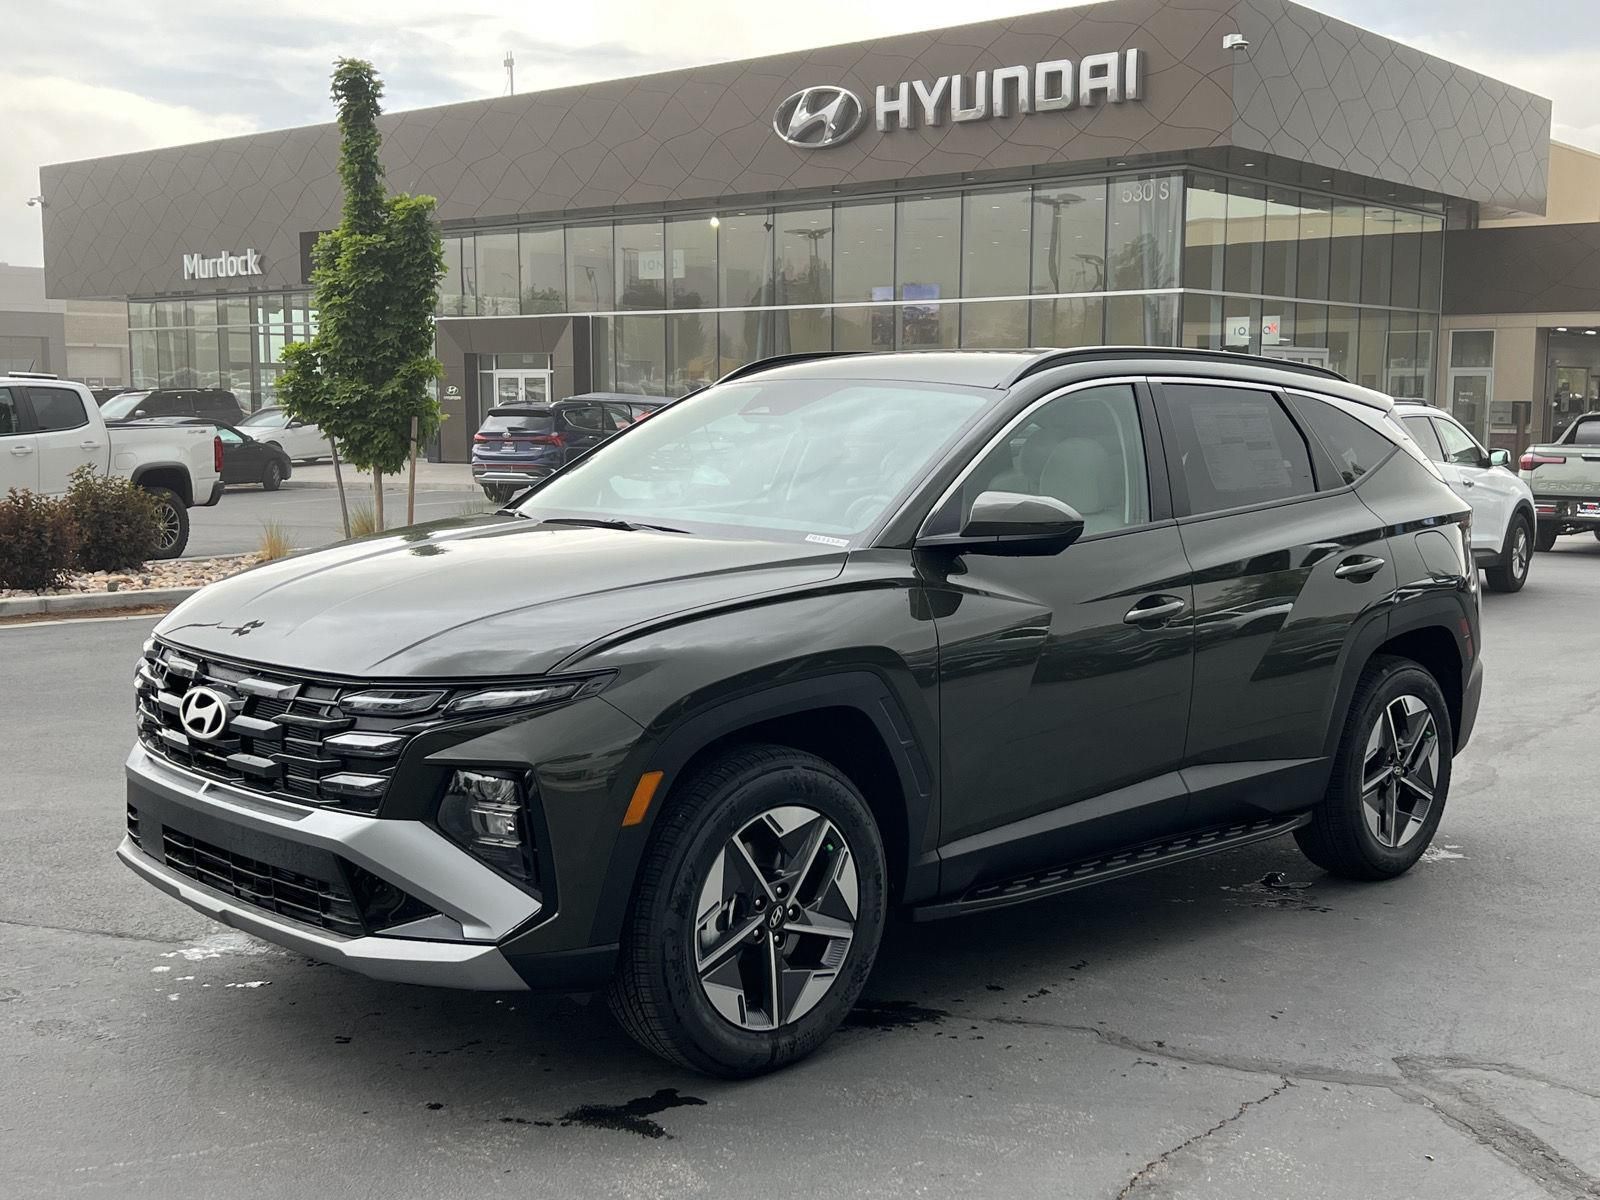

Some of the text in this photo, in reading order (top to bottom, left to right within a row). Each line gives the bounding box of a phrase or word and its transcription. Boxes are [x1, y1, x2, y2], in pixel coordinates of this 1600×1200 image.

[876, 48, 1143, 132] HYUNDAI
[1159, 181, 1170, 200] S
[183, 248, 262, 280] Murdock
